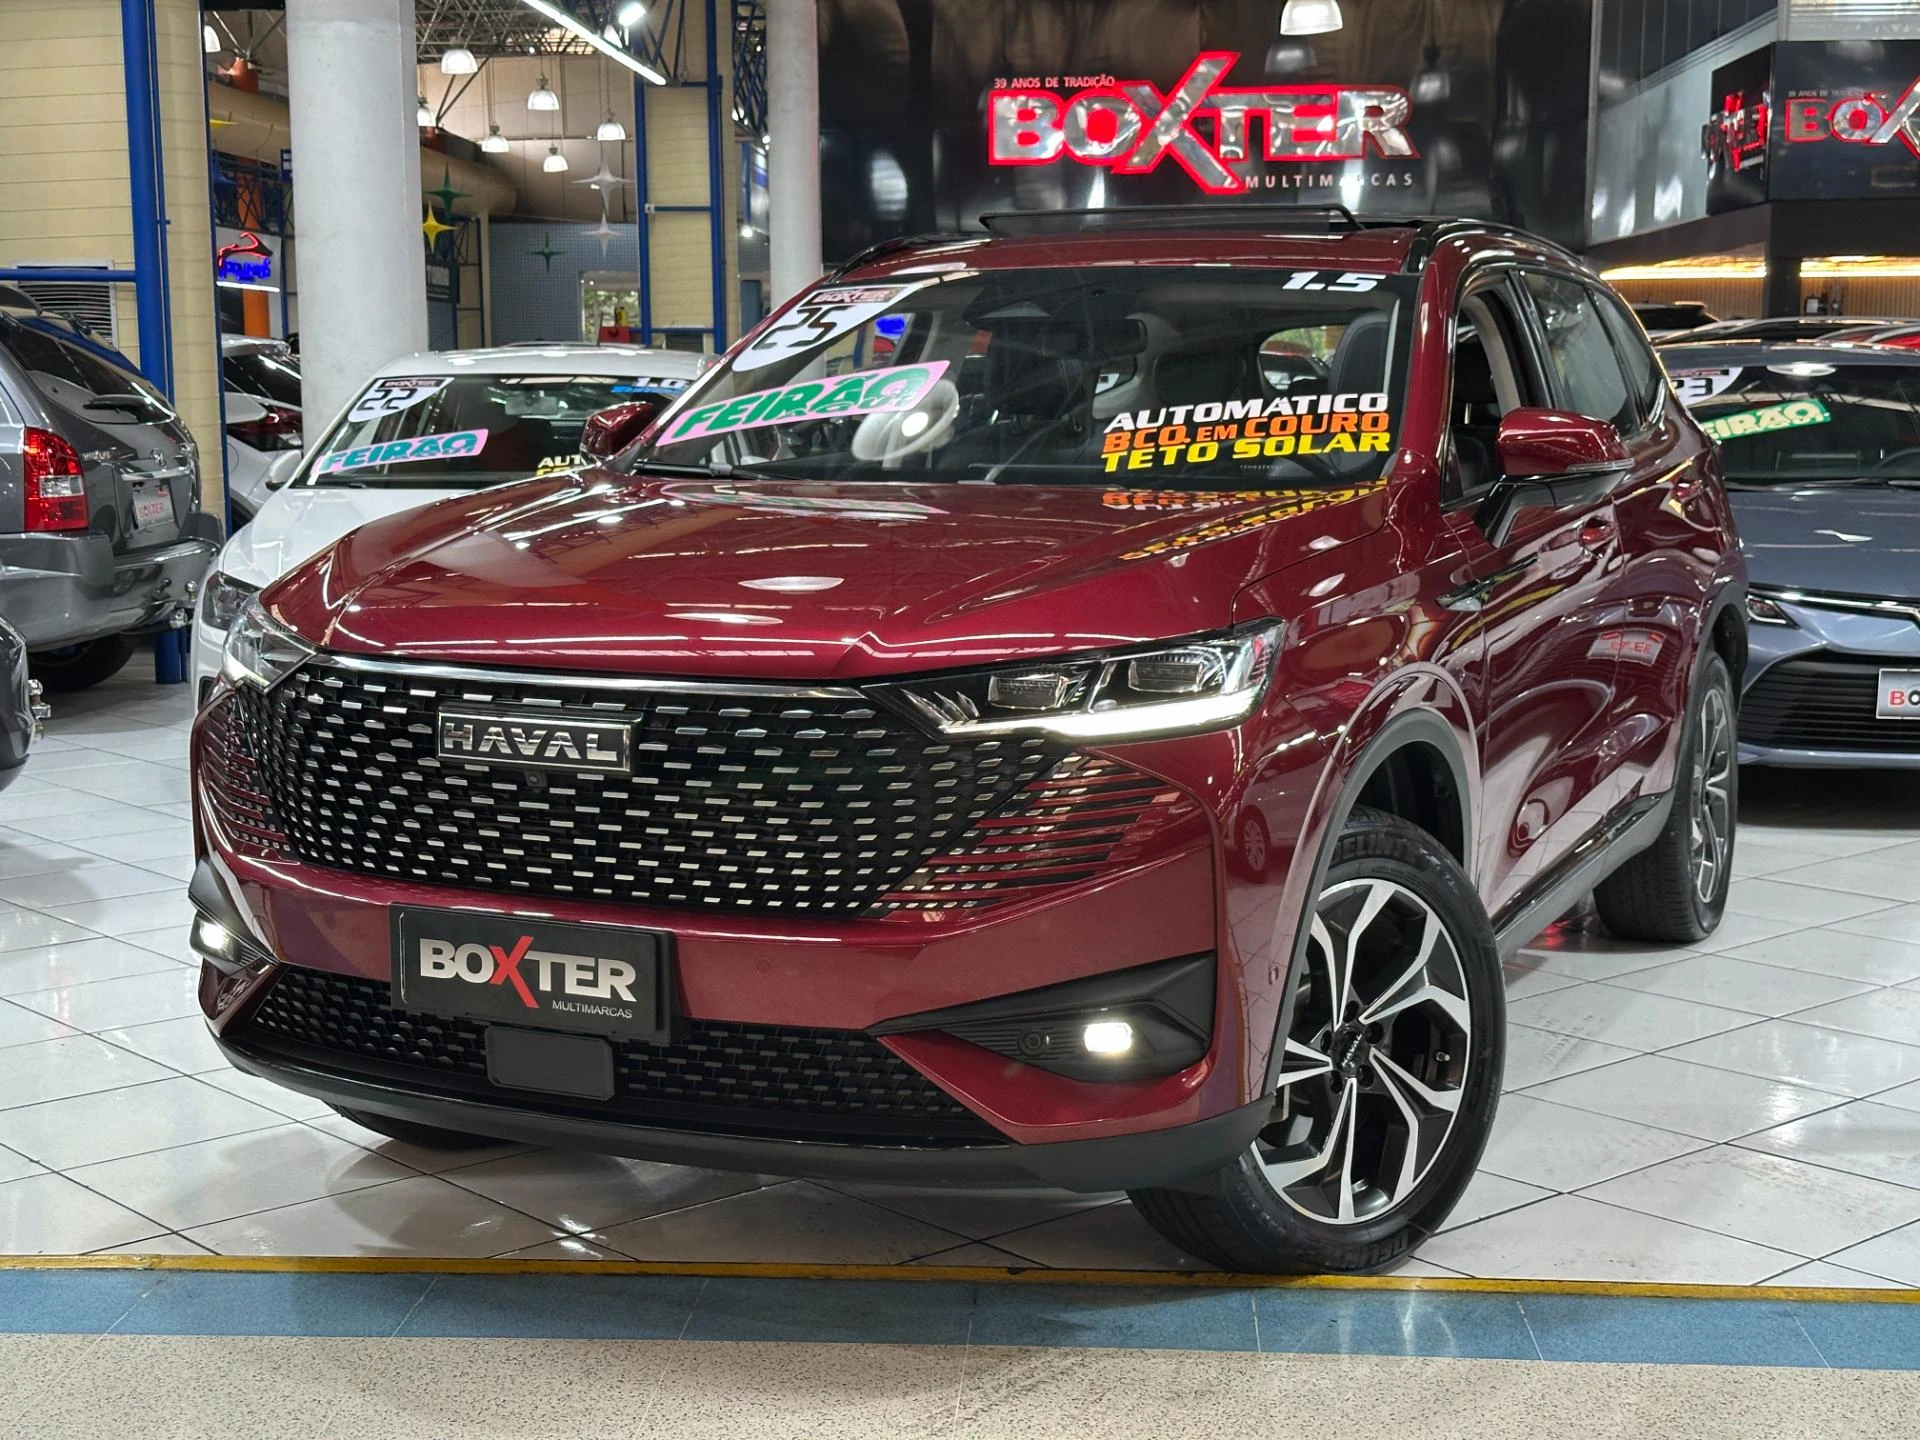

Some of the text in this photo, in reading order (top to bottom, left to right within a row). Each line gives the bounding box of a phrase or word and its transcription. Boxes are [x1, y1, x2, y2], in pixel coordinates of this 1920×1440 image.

[994, 73, 1115, 89] 39 ANOS DE TRADIÇÃO
[988, 51, 1421, 194] BOXTER
[1245, 173, 1413, 188] MULTIMCAS
[1282, 271, 1386, 292] 1.5
[752, 305, 855, 350] 25
[357, 389, 418, 411] 22
[672, 367, 931, 438] FEIRÃO
[1196, 424, 1237, 442] EM
[1244, 412, 1389, 438] COURO
[319, 433, 478, 472] FEIRÃO
[1101, 432, 1390, 472] TETO SOLAR
[443, 723, 618, 762] HAVAL
[419, 935, 638, 1009] BOXTER
[552, 1000, 633, 1019] MULTIMARCAS
